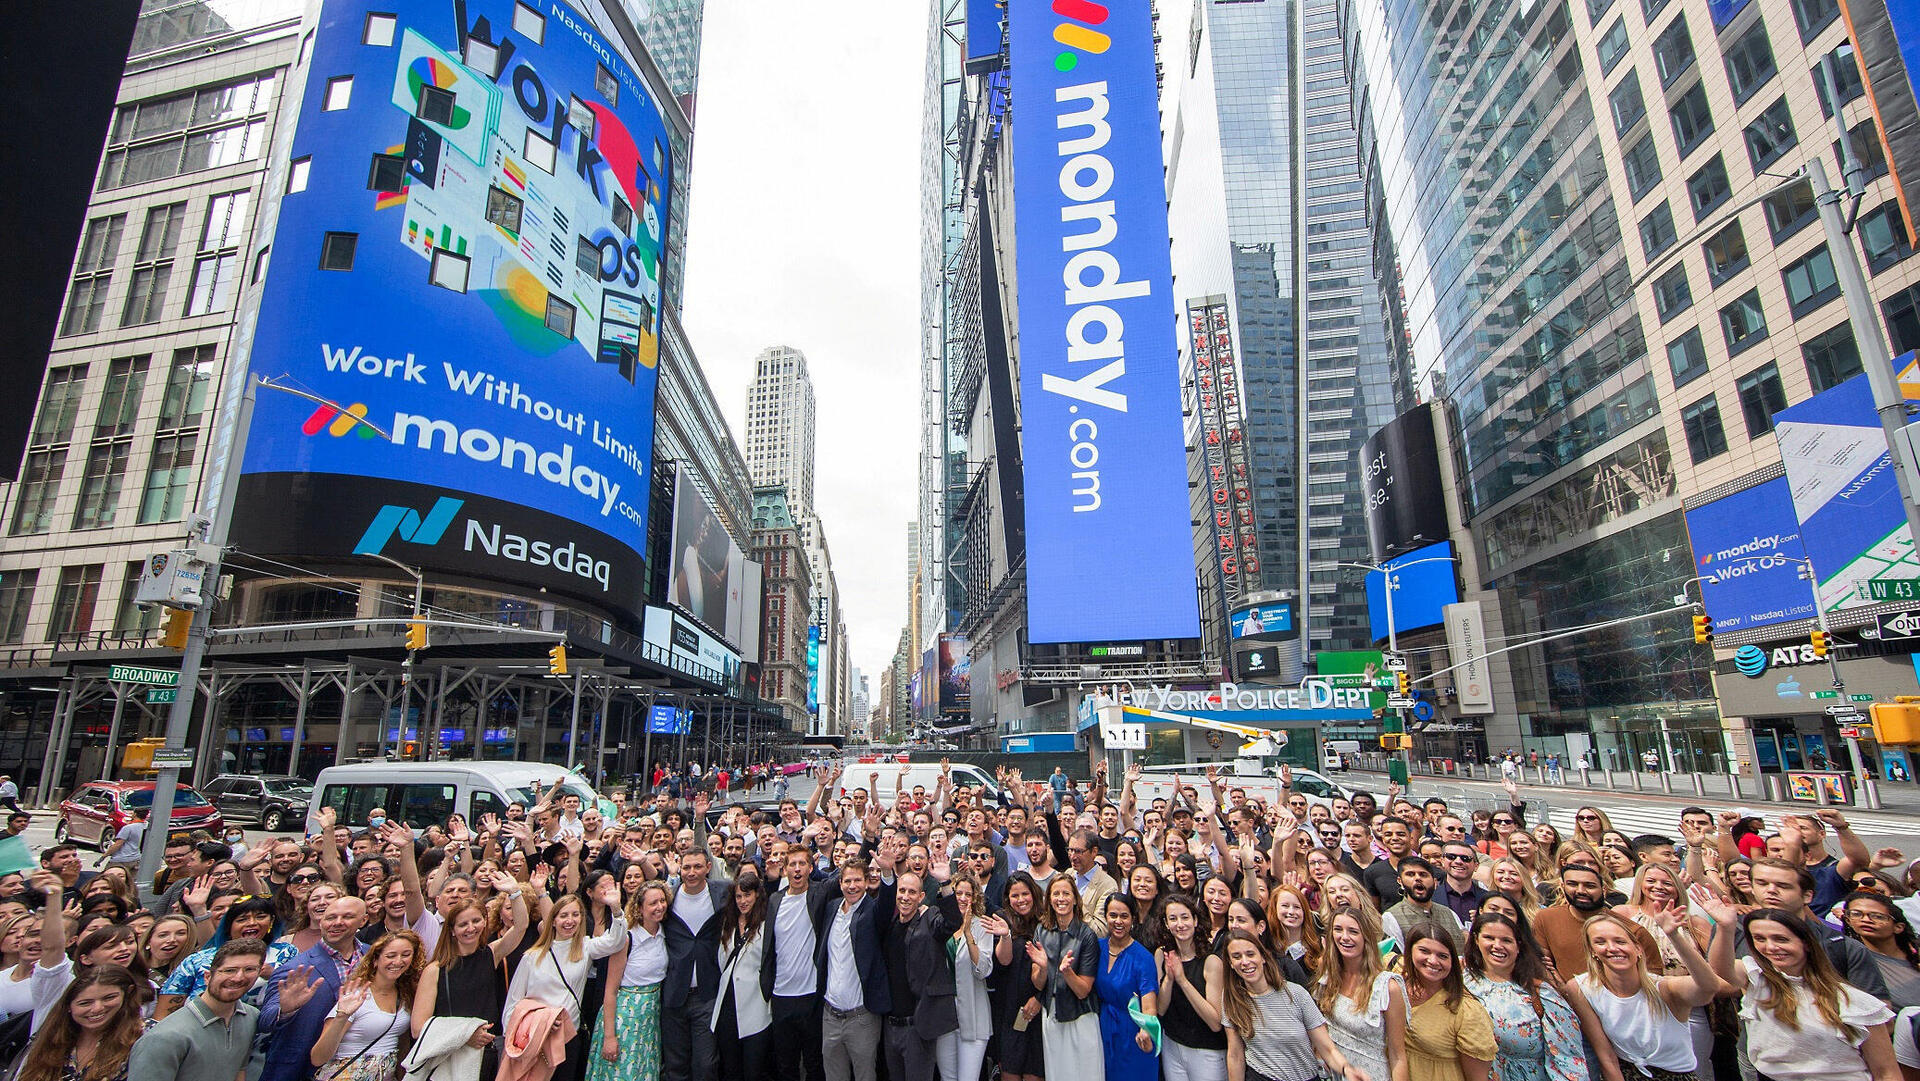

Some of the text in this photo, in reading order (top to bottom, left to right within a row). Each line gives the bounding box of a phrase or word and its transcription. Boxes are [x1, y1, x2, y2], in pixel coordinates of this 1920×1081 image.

[551, 4, 646, 107] Nasdaq Listed
[453, 0, 602, 206] Work
[600, 236, 641, 289] OS
[1042, 81, 1150, 513] monday.com
[322, 343, 643, 476] Work Without Limits
[1194, 316, 1214, 409] ERNST
[1211, 465, 1237, 575] YOUNG
[391, 411, 642, 528] monday.com
[464, 519, 611, 592] Nasdaq
[1716, 534, 1799, 561] monday.com
[1716, 552, 1787, 581] Work OS
[1872, 581, 1913, 598] W 43
[1716, 603, 1814, 629] MNDY Nasdaq Listed
[1462, 618, 1473, 647] REUTERS
[1771, 643, 1830, 666] AT&
[112, 667, 176, 684] BROADWAY
[1336, 677, 1355, 685] BIGO
[149, 691, 157, 702] W
[158, 691, 170, 702] 43
[1151, 682, 1216, 711] YORK
[1220, 682, 1300, 710] POLICE
[1308, 680, 1374, 709] DEPT
